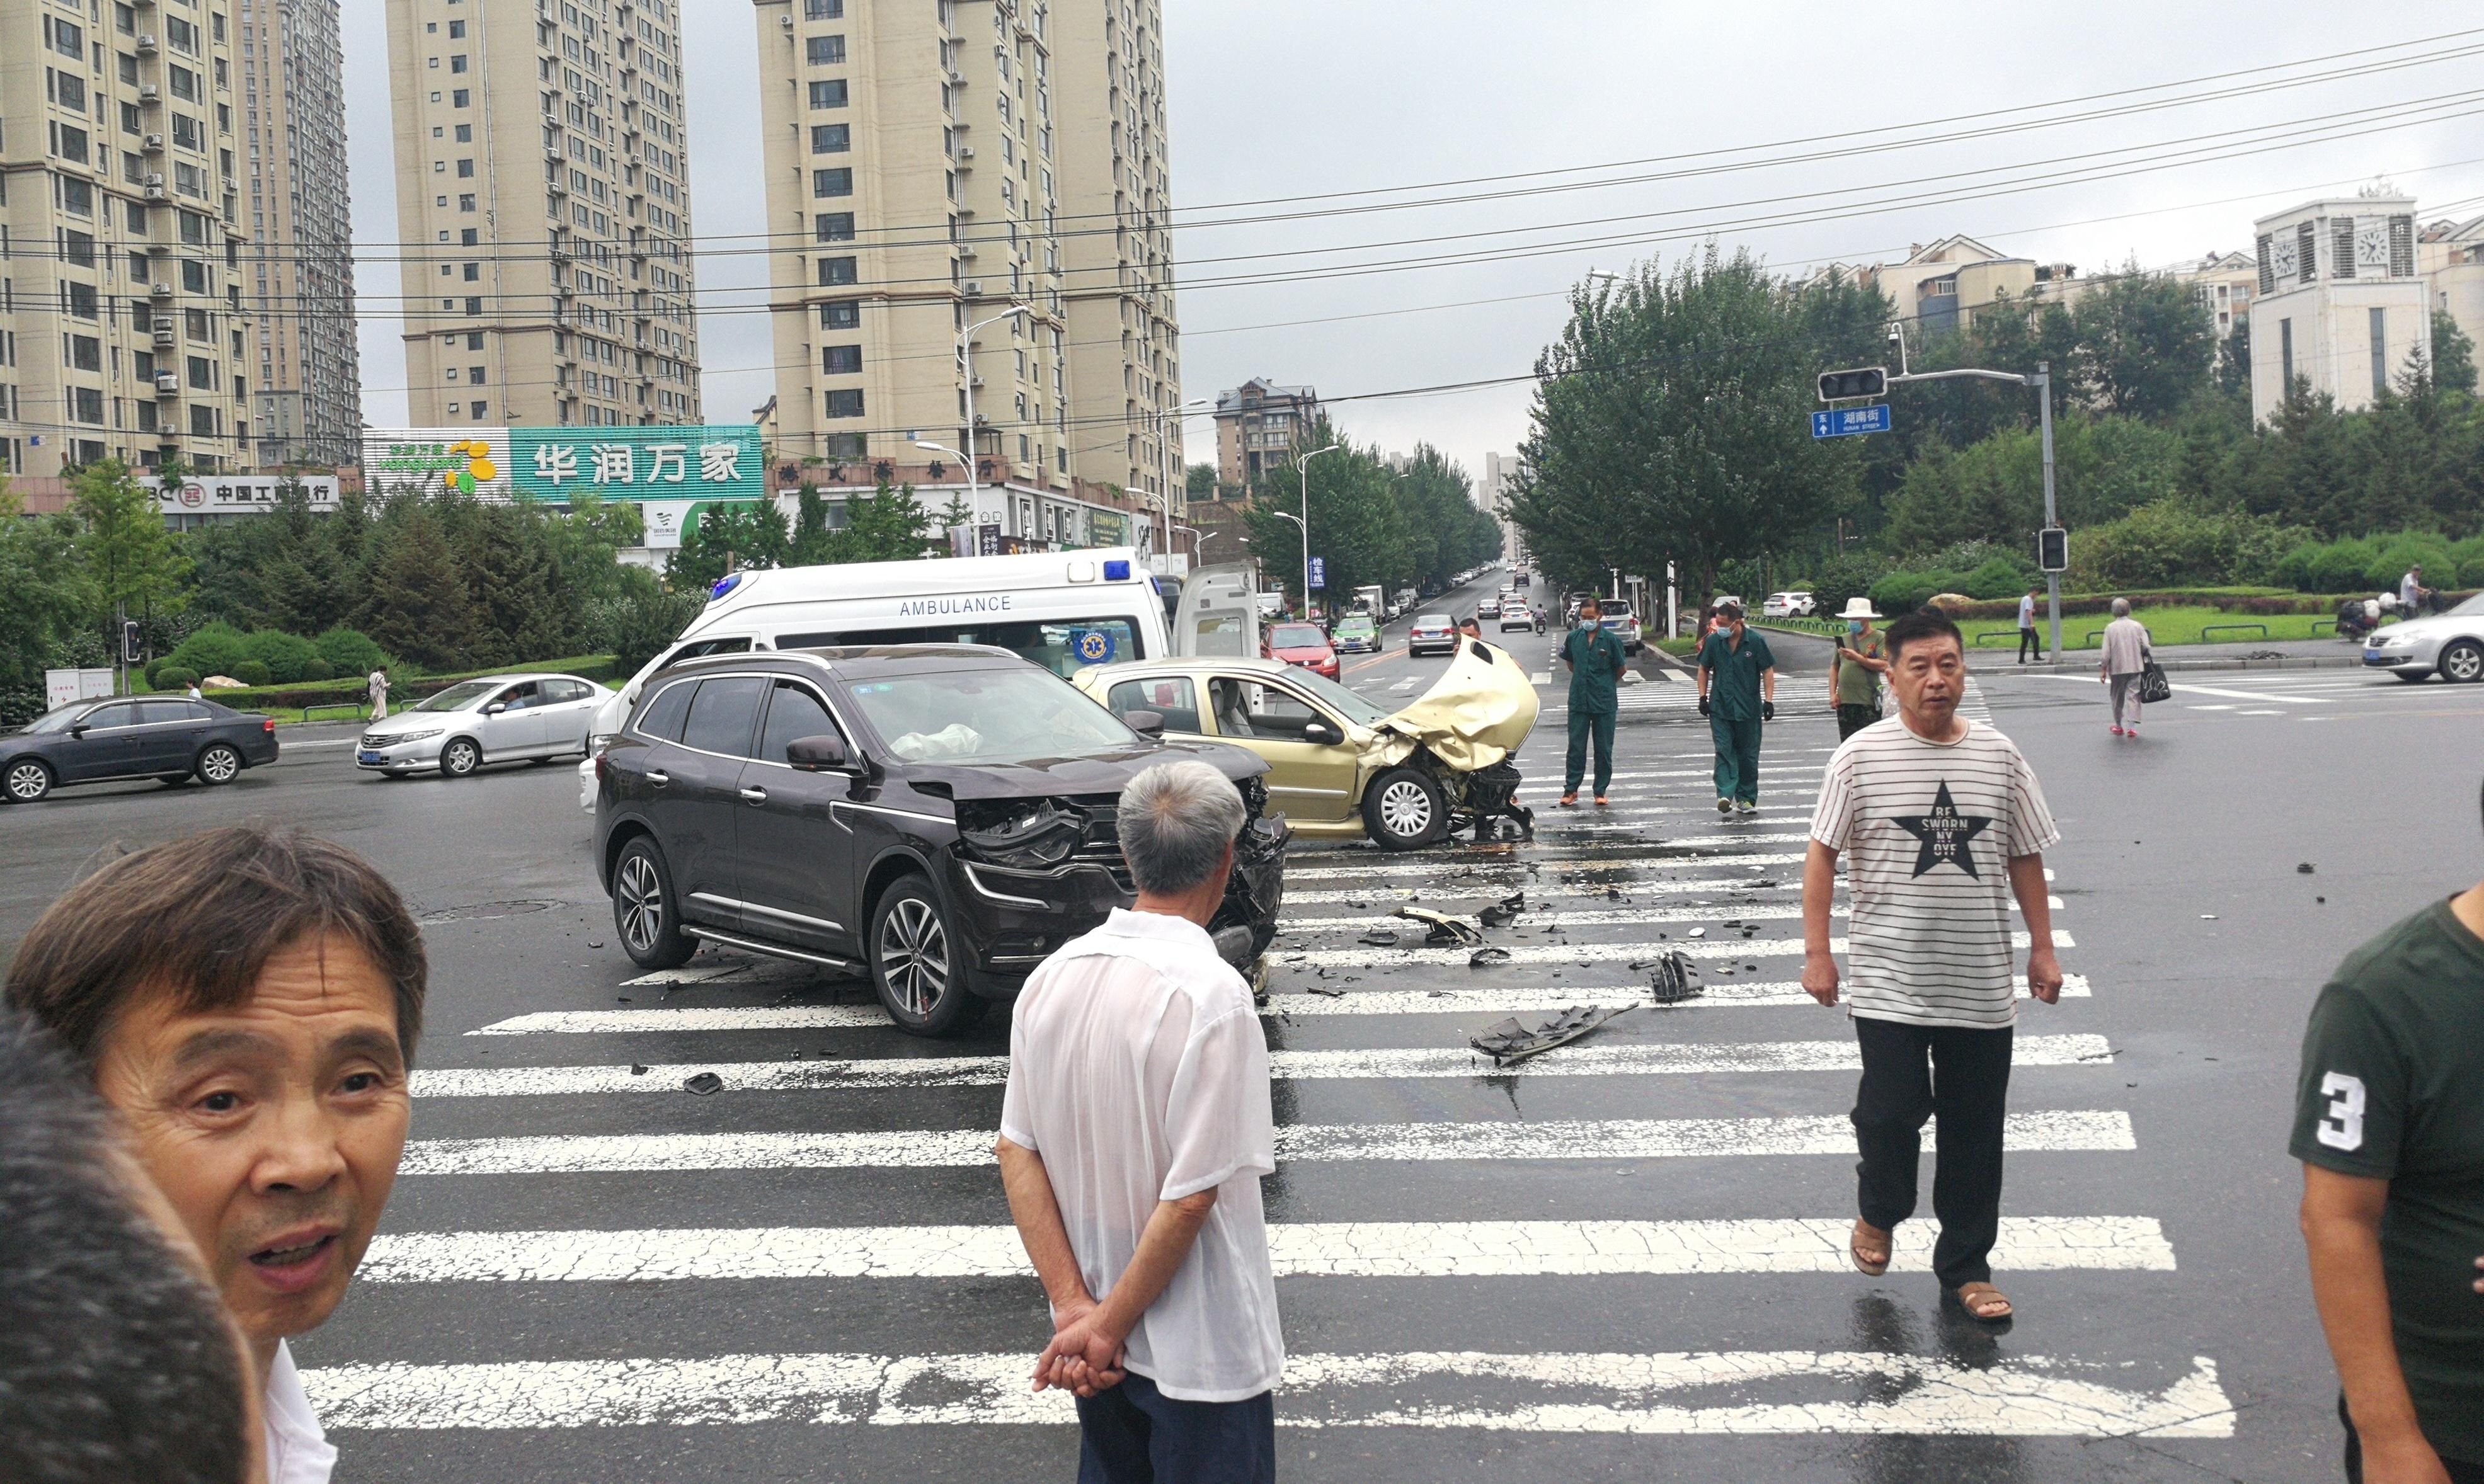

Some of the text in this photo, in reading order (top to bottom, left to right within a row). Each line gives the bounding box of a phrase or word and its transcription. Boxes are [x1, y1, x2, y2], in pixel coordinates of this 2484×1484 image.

[1818, 414, 1827, 423] 东
[1843, 409, 1879, 425] 湖南街
[379, 454, 464, 474] vanguard
[534, 442, 741, 486] 华润万家
[216, 484, 329, 501] 中国工行
[900, 596, 1011, 616] AMBULANCE
[1921, 819, 1968, 831] SWORN
[1937, 831, 1953, 843] NY
[2317, 1071, 2366, 1151] 3
